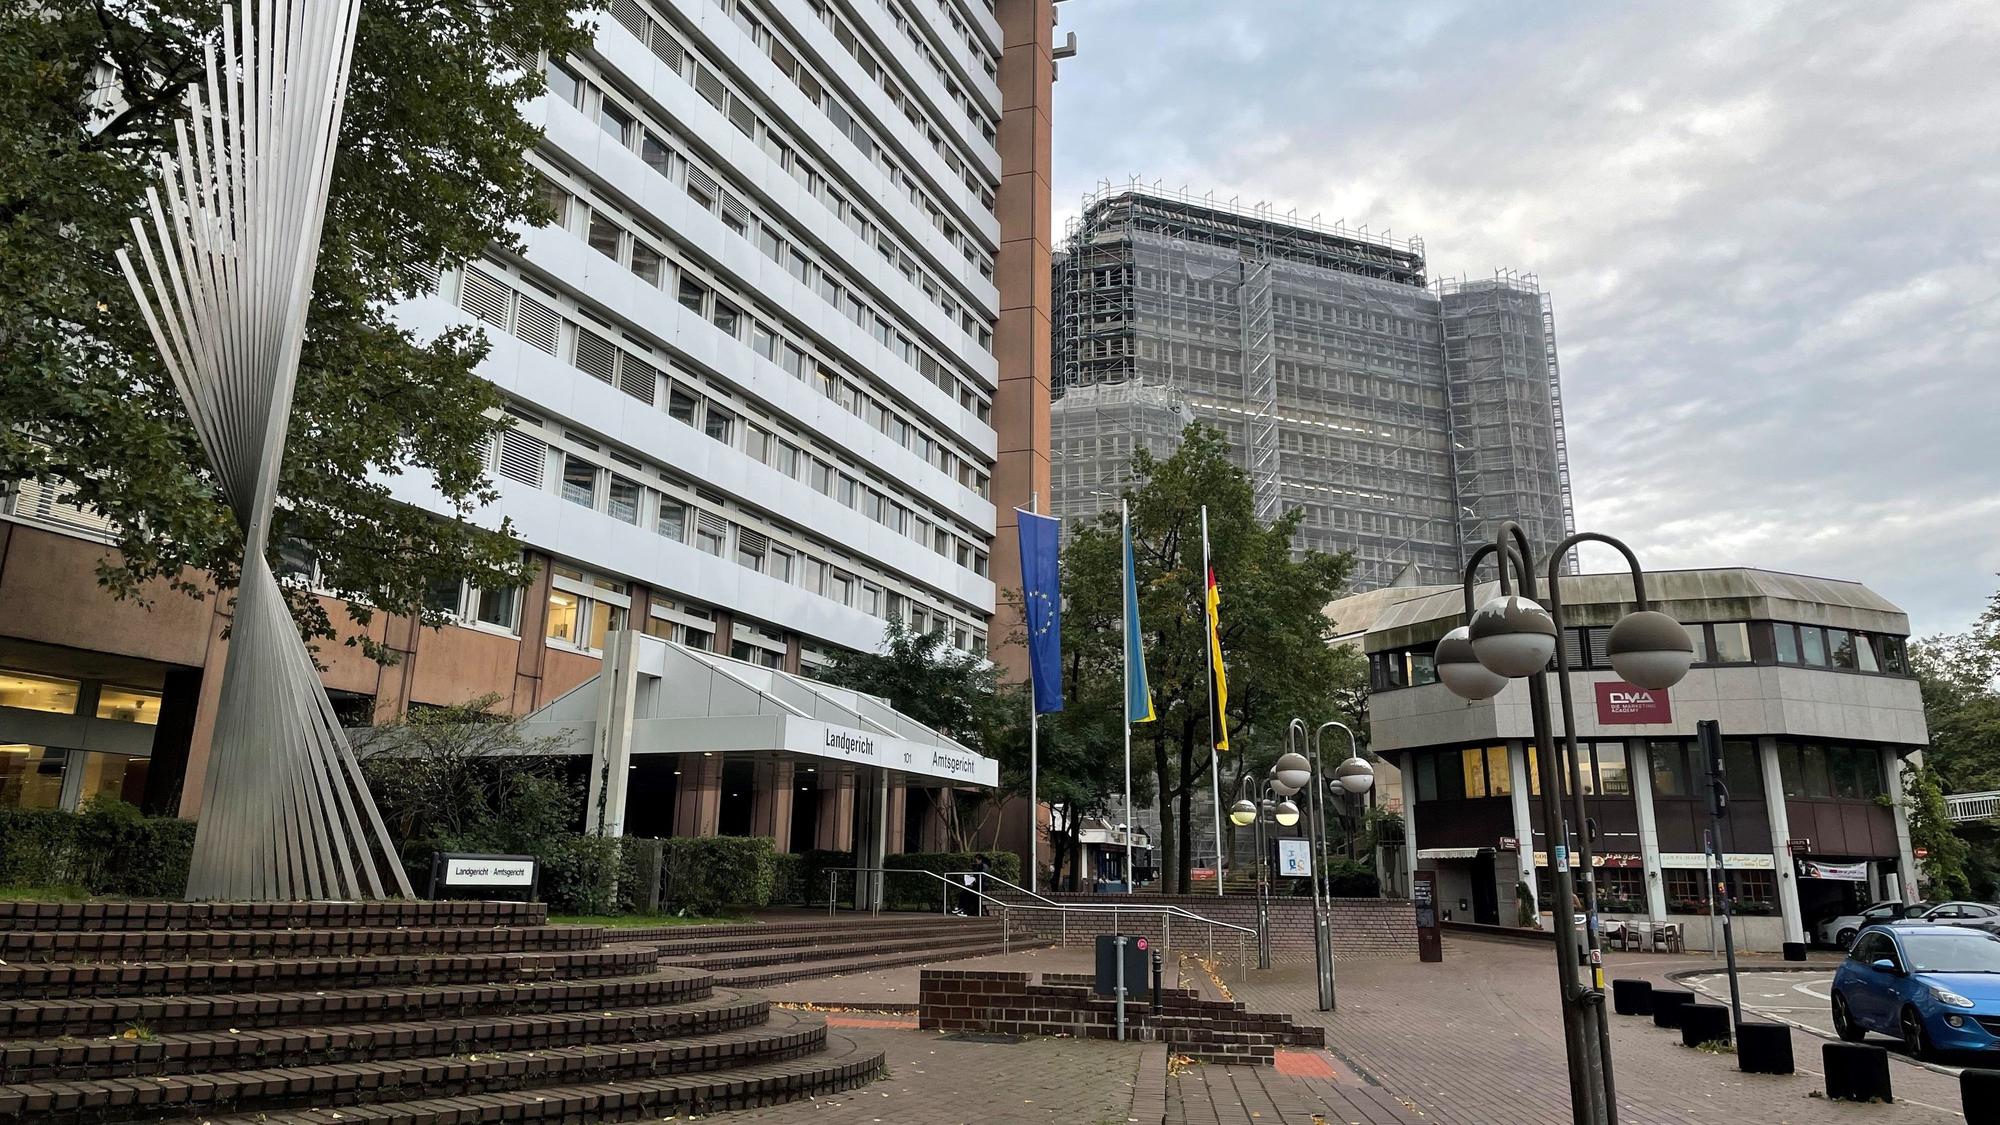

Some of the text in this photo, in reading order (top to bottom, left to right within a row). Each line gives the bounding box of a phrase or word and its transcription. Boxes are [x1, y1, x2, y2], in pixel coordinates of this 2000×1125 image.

[1610, 692, 1655, 703] DMA
[826, 728, 975, 774] Landgericht 101 Amtsgericht
[455, 867, 525, 877] Landgericht Amtsgericht
